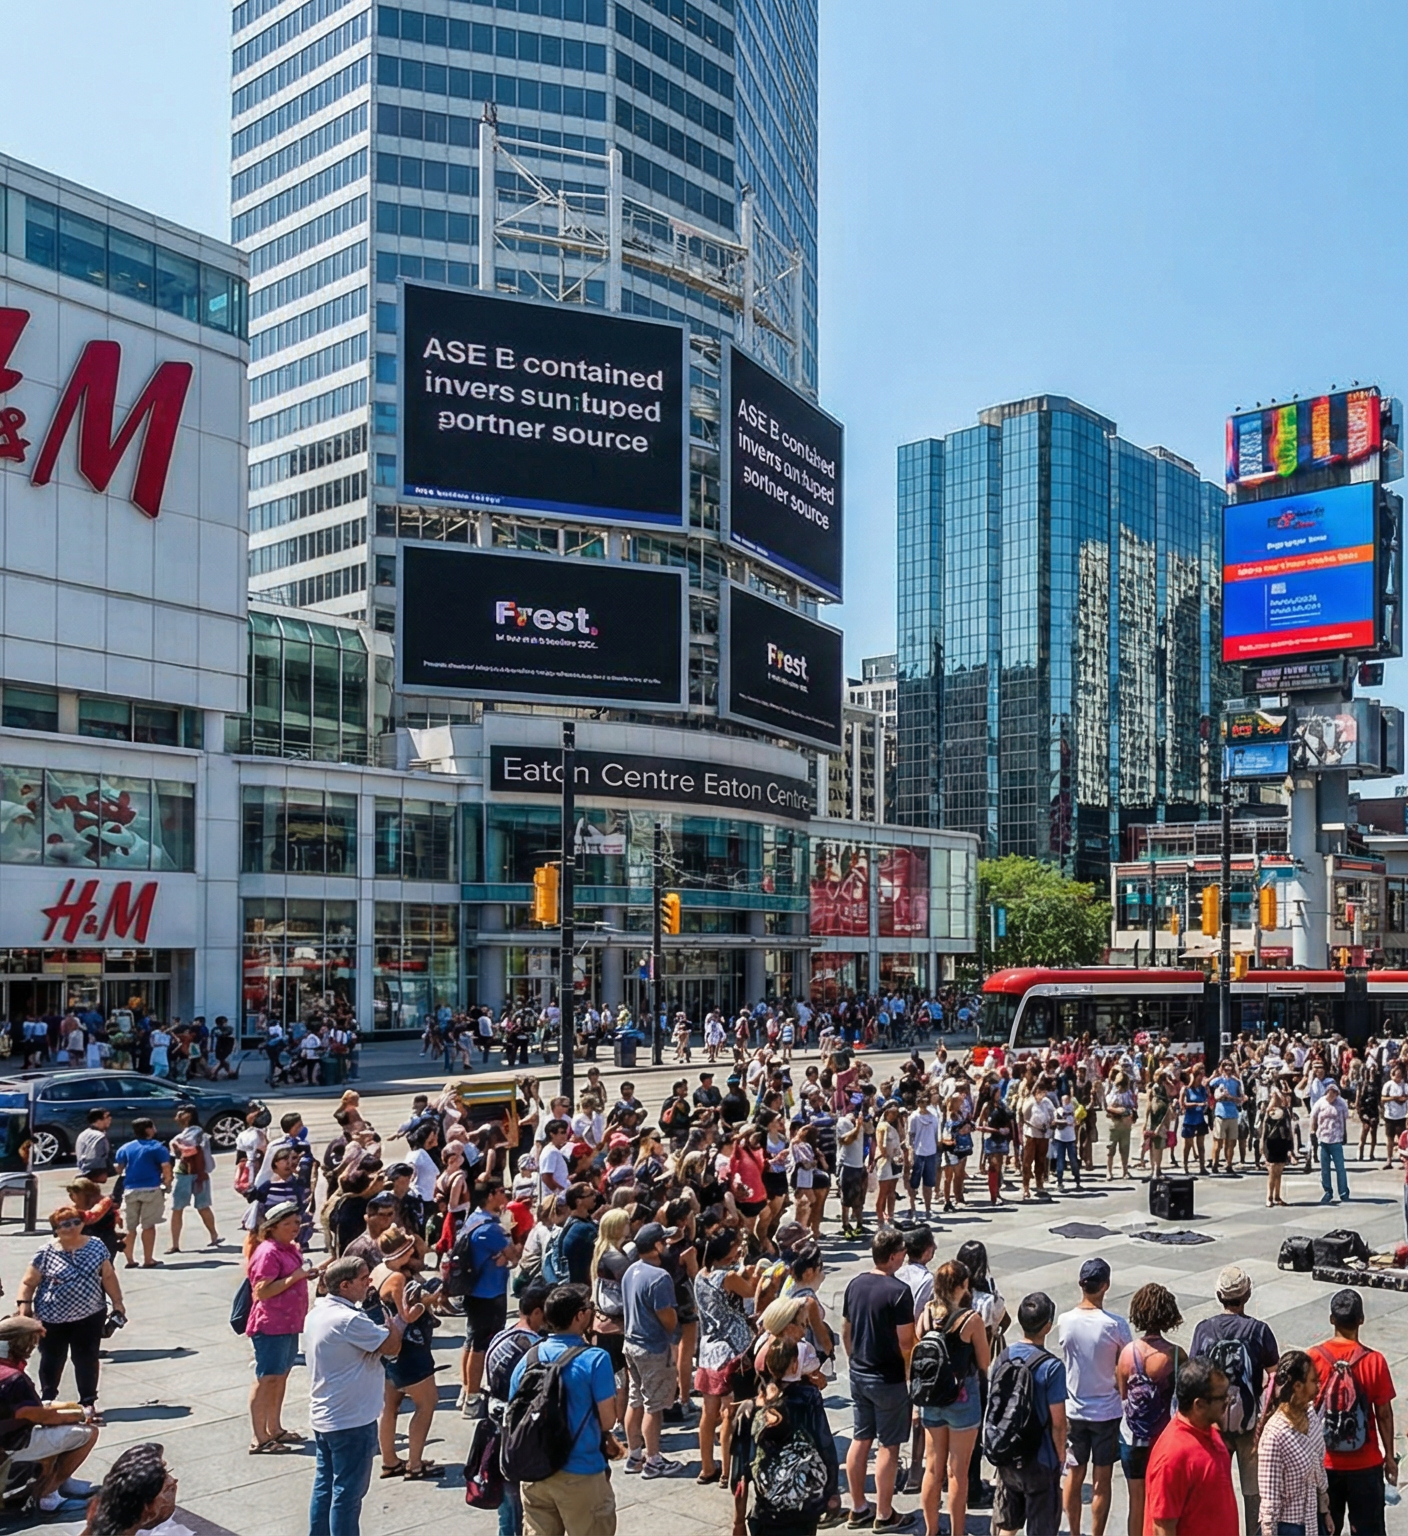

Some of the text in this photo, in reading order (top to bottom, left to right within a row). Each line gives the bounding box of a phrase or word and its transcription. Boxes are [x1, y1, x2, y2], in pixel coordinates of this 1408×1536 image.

[423, 337, 487, 367] ASE
[523, 356, 664, 392] contained
[425, 370, 515, 403] invers
[738, 398, 768, 435] ASE
[551, 424, 649, 453] source
[790, 494, 830, 531] source
[601, 762, 695, 793] Centre
[704, 772, 762, 801] Eaton
[766, 782, 810, 813] Centre
[41, 878, 158, 944] H&M
